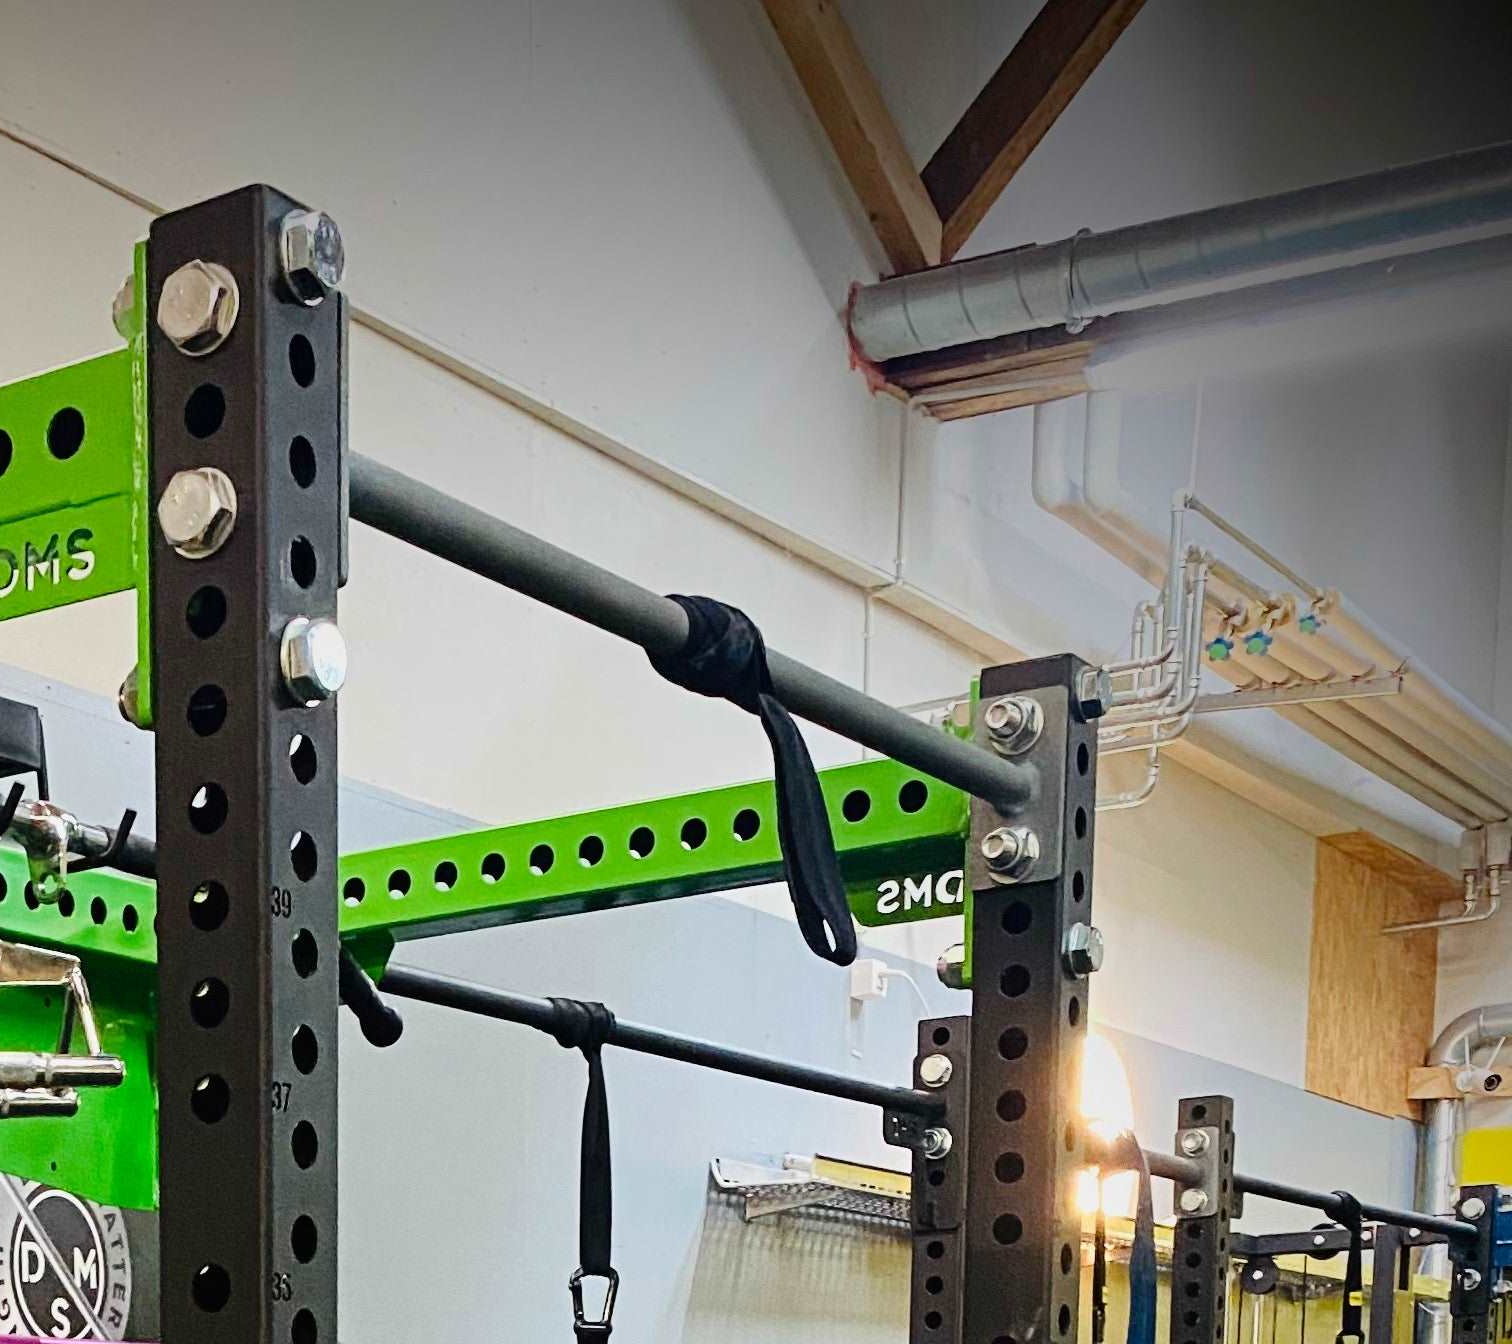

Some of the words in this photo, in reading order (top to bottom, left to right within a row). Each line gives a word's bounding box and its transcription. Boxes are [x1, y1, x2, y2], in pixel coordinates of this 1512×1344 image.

[271, 889, 292, 919] 39
[271, 1081, 292, 1112] 37
[102, 1212, 128, 1330] ATTER
[271, 1272, 292, 1302] 35
